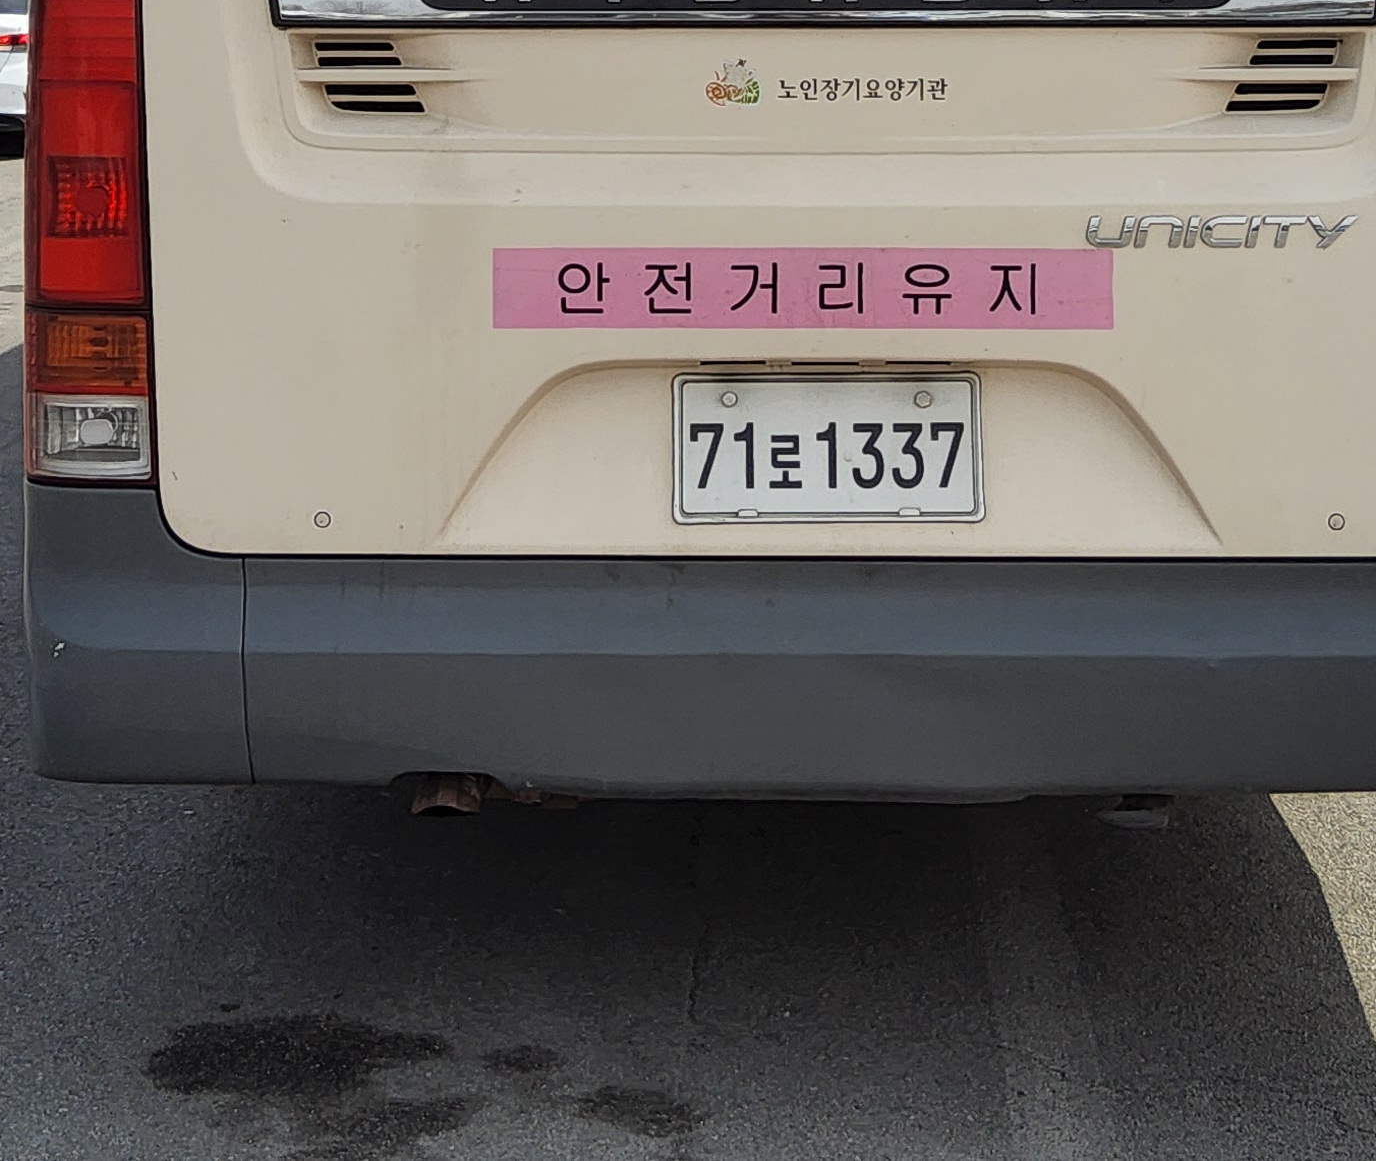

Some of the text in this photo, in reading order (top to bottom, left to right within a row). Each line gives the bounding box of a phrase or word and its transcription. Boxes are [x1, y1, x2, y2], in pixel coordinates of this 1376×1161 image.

[777, 78, 949, 102] 노인장기요양기관
[1085, 215, 1359, 250] UNICITY
[557, 261, 1038, 316] 안전거리유지
